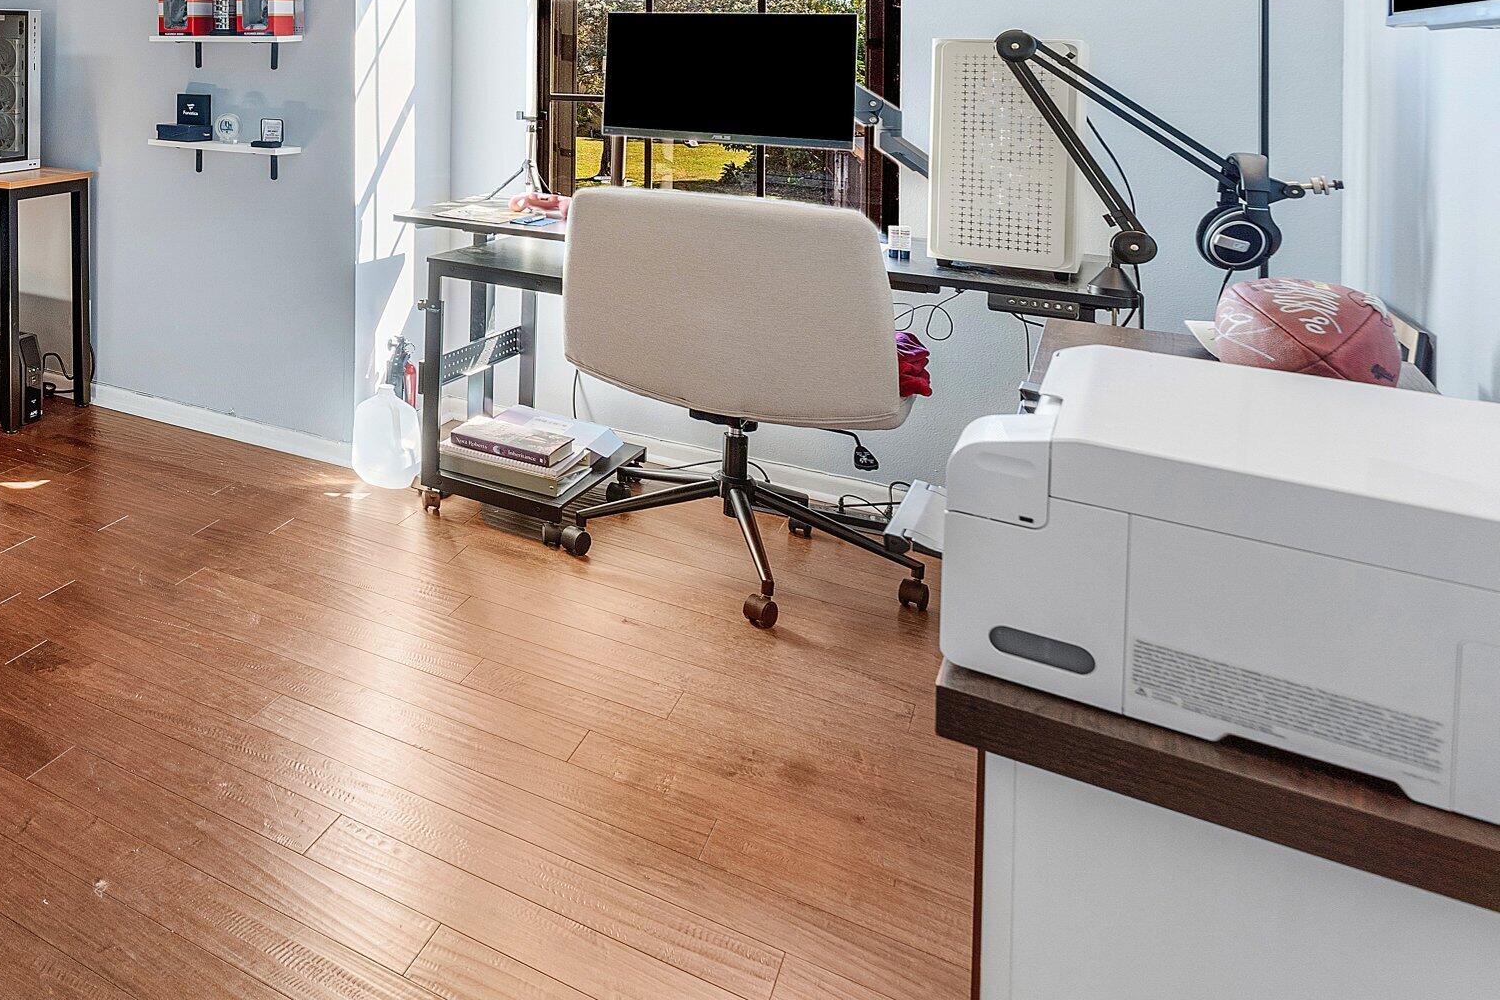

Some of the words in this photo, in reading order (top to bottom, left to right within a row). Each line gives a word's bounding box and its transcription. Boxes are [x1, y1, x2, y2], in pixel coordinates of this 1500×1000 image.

[455, 437, 468, 445] Nora
[468, 440, 488, 449] Roberts
[508, 449, 536, 462] Inheritance
